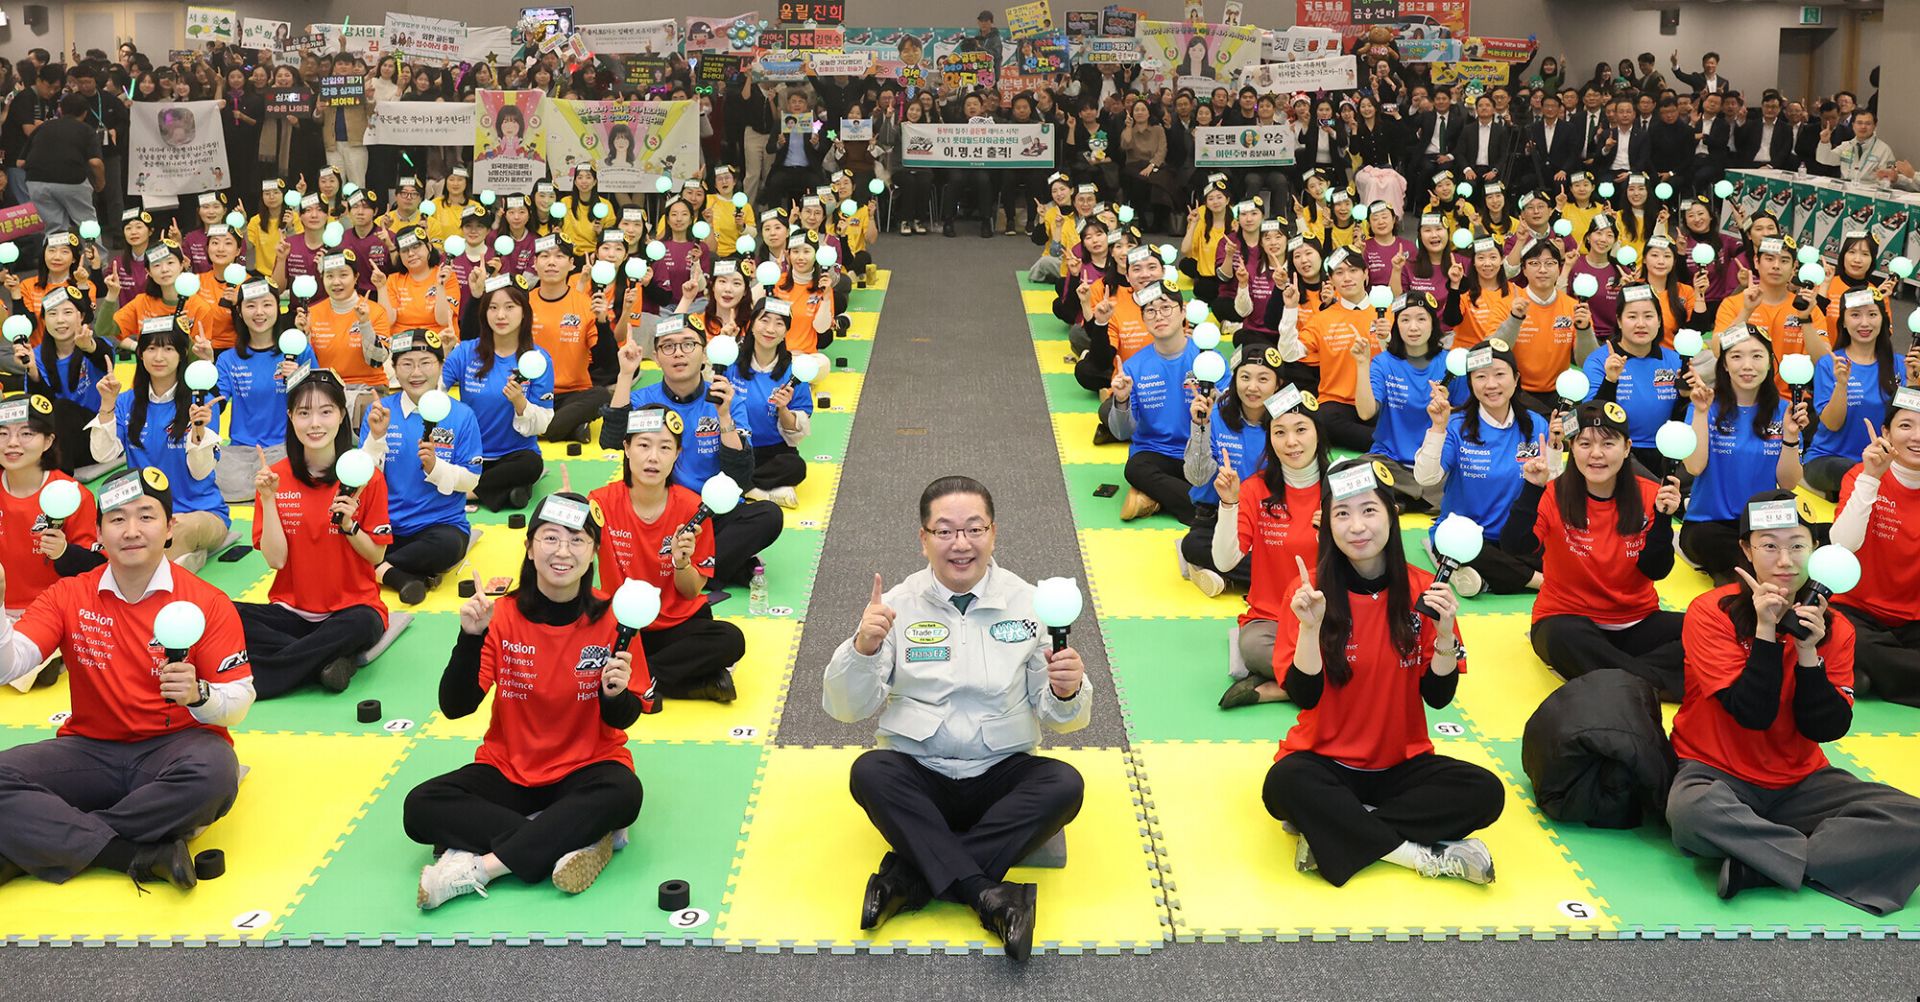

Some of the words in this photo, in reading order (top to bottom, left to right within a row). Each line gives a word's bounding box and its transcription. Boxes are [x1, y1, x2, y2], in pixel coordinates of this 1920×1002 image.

[779, 4, 808, 20] 울릴
[814, 4, 843, 21] 진희
[1304, 11, 1349, 22] Foreign
[1354, 9, 1395, 19] 금융센터
[789, 34, 814, 46] SK
[816, 33, 842, 46] 김현수
[368, 40, 379, 51] 김
[953, 136, 1019, 144] 롯데월드타워금융센터
[1205, 134, 1236, 145] 골든벨
[1264, 133, 1283, 144] 우승
[944, 147, 983, 158] 이.명.선
[987, 146, 1012, 158] 출격!
[1216, 150, 1247, 158] 이현주면
[427, 333, 439, 344] 27
[1267, 350, 1279, 364] 25
[1138, 380, 1165, 390] Openness
[1385, 380, 1408, 391] Openness
[36, 396, 50, 410] 18
[1139, 394, 1166, 402] Excellence
[1304, 393, 1315, 408] 15
[668, 414, 681, 430] 16
[697, 446, 713, 454] Hana
[1216, 440, 1243, 450] Openness
[1460, 446, 1490, 456] Openness
[1380, 467, 1388, 478] 5
[1460, 463, 1490, 471] Excellence
[152, 472, 160, 483] 7
[1463, 471, 1487, 479] Respect
[275, 490, 301, 499] assion
[595, 507, 601, 519] 6
[1804, 503, 1811, 516] 4
[912, 629, 932, 637] Trade
[74, 643, 112, 660] Excellence
[933, 650, 944, 658] EZ
[151, 656, 163, 666] Tra
[151, 667, 163, 676] Ha
[387, 721, 411, 730] 17
[1438, 724, 1461, 733] 15
[733, 728, 756, 736] 16
[1566, 902, 1588, 918] 5
[237, 913, 260, 928] 7
[678, 910, 700, 926] 6
